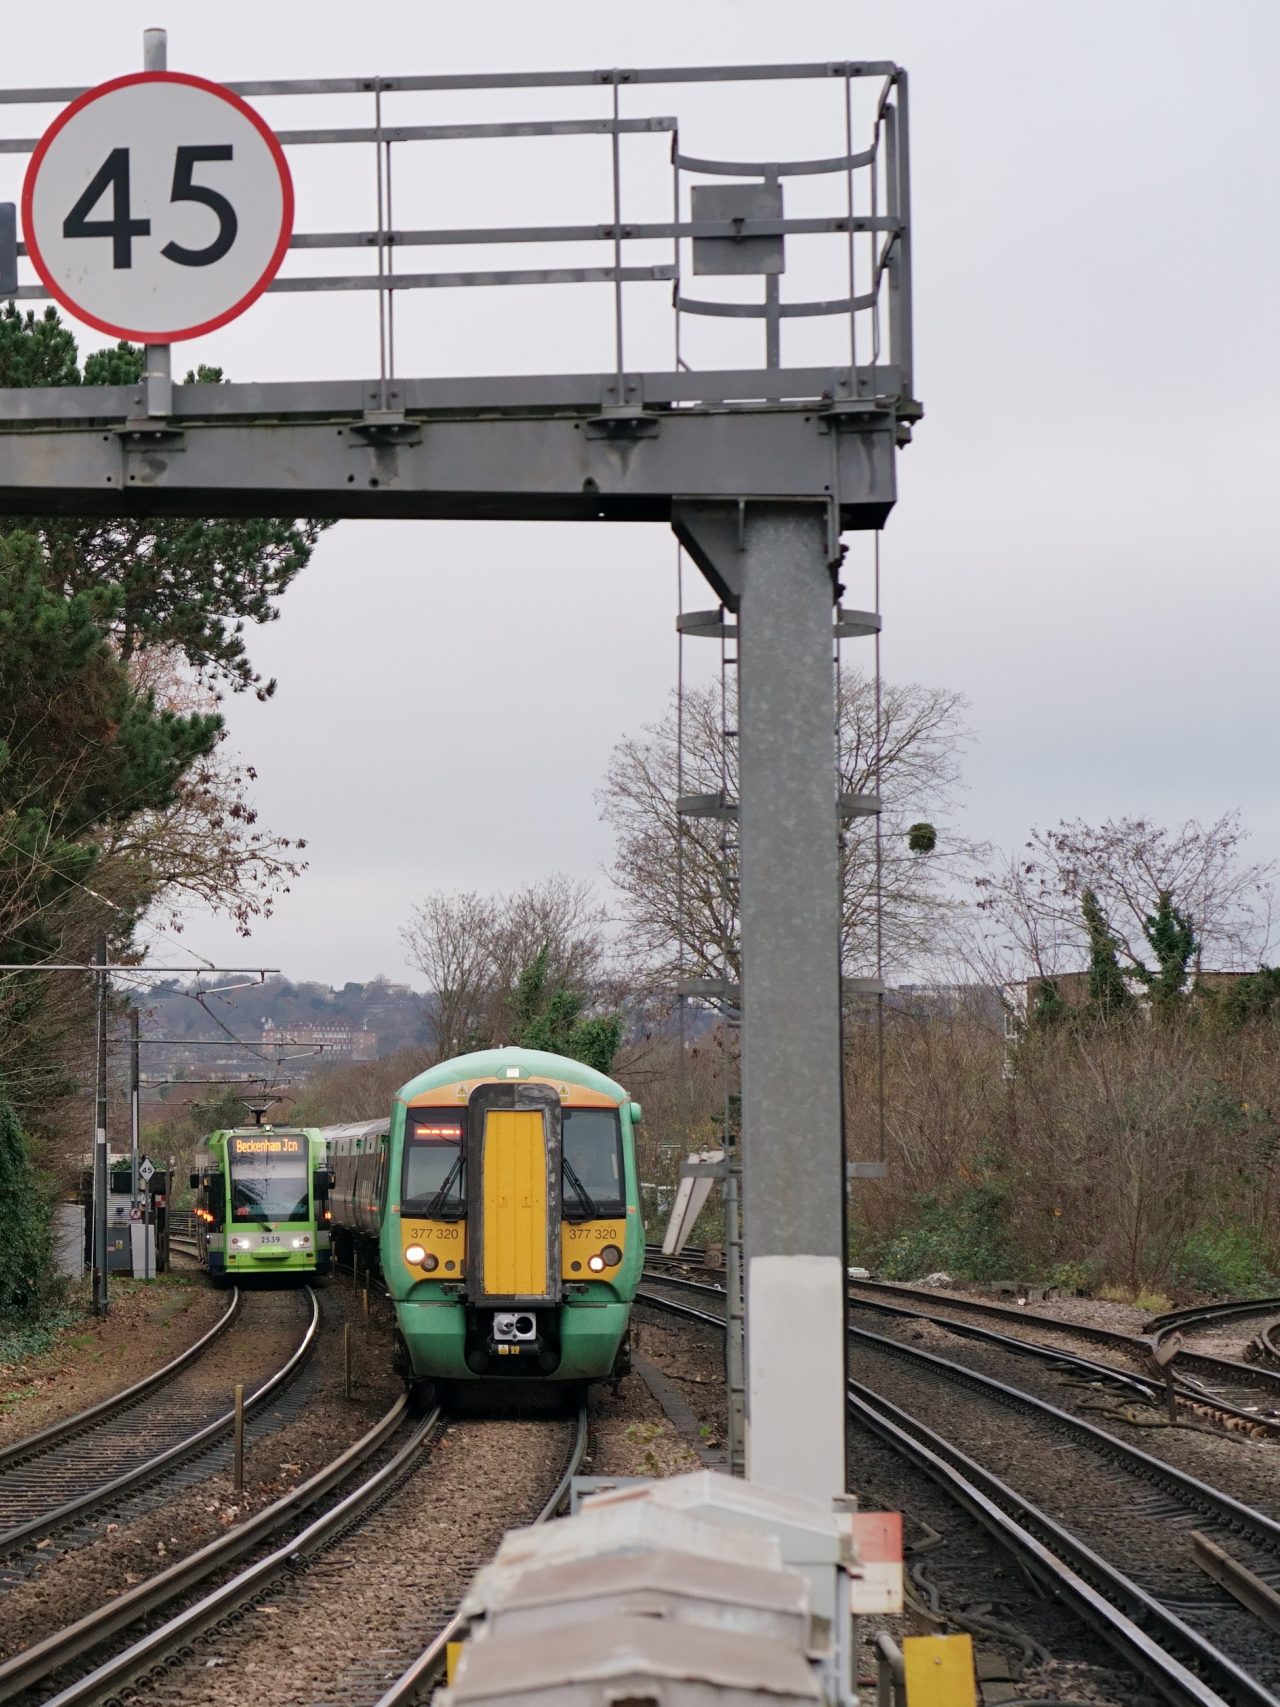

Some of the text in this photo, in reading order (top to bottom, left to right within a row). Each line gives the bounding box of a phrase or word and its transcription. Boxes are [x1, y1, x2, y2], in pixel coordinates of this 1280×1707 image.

[63, 144, 238, 269] 45
[236, 1138, 298, 1153] Beckenham Jcn
[261, 1236, 281, 1244] 2539
[411, 1228, 459, 1240] 377 320
[569, 1228, 617, 1240] 377 320
